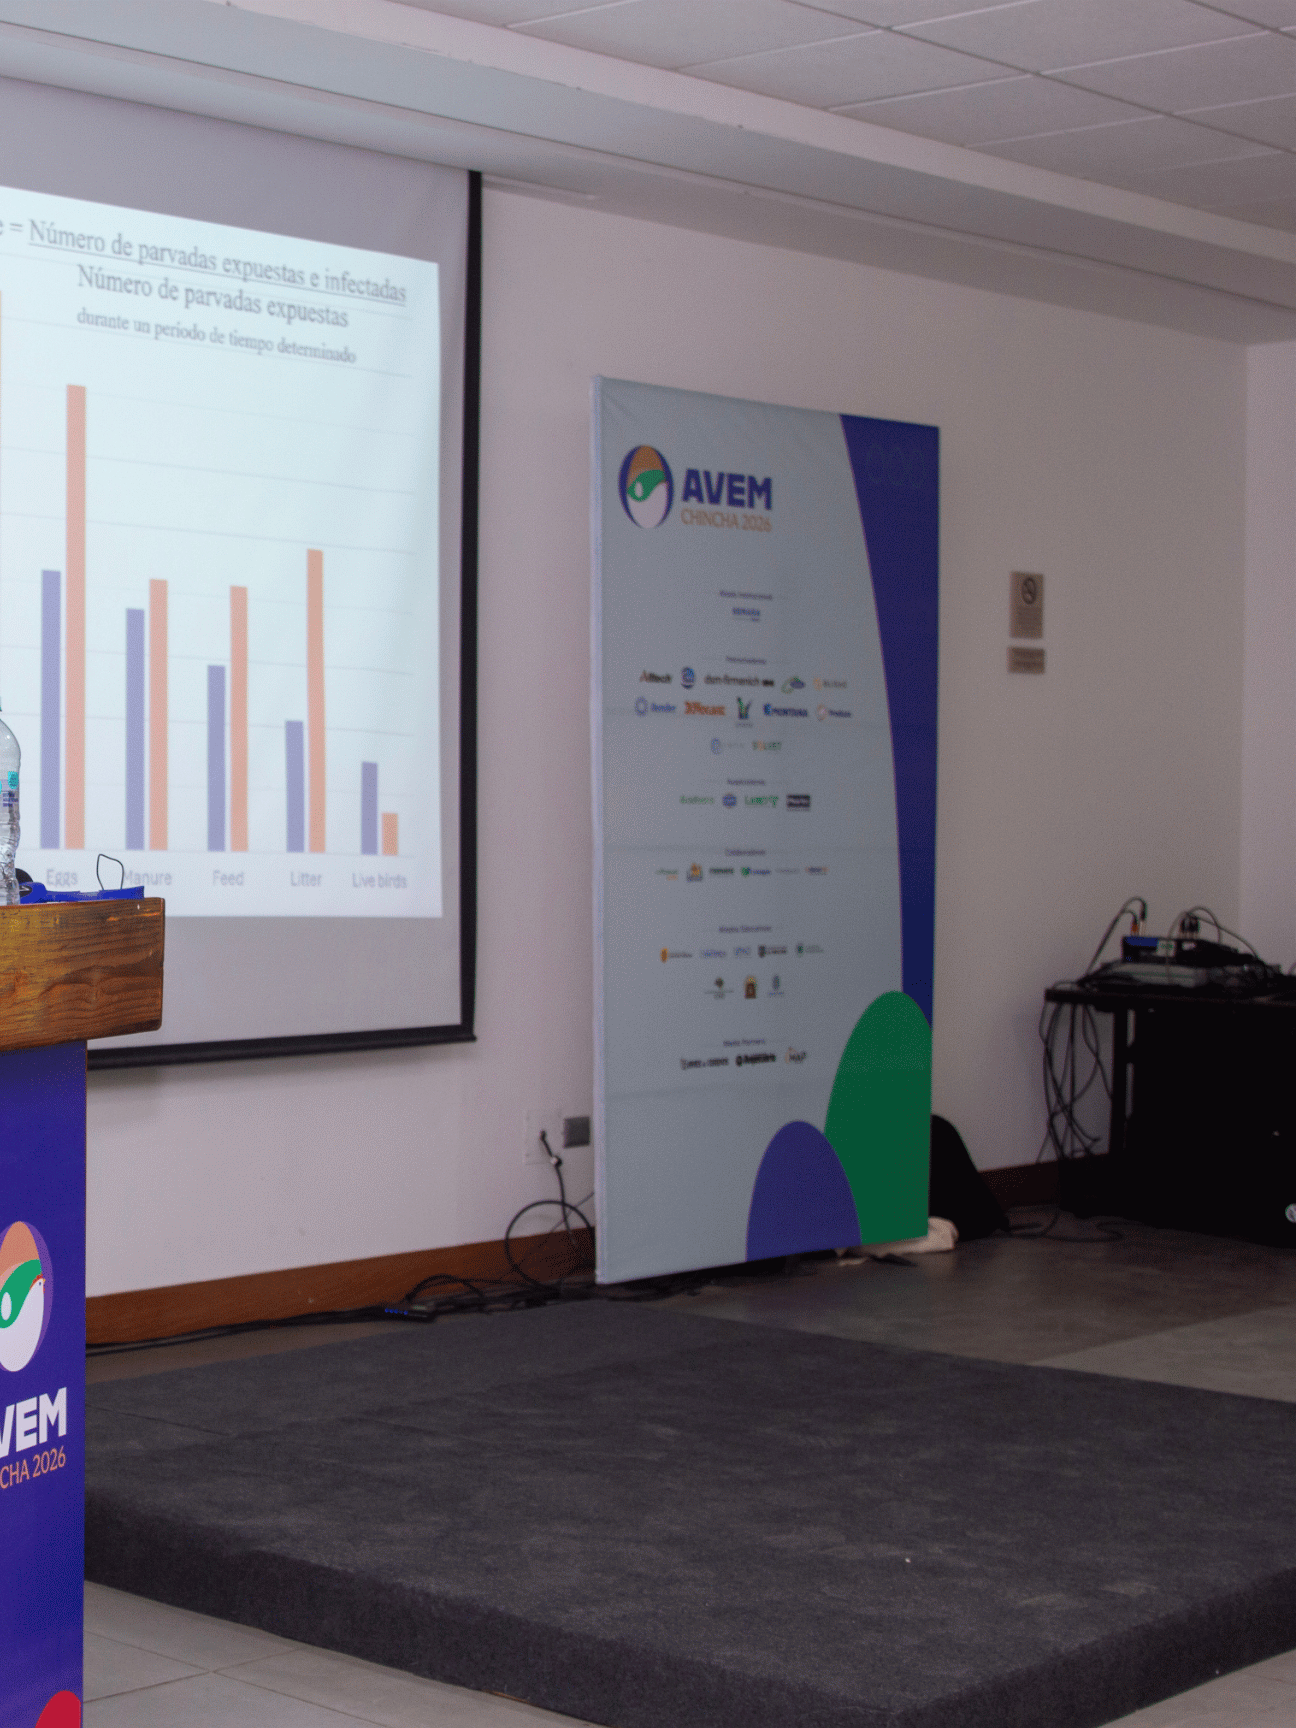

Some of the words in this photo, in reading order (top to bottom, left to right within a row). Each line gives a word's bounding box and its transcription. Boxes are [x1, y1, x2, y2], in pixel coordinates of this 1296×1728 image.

[29, 217, 105, 252] Número
[111, 233, 133, 257] de
[138, 239, 217, 273] parvadas
[222, 256, 304, 290] expuestas
[310, 272, 321, 288] e
[325, 268, 406, 302] infectadas
[77, 263, 152, 298] Número
[158, 277, 179, 302] de
[184, 283, 261, 317] parvadas
[266, 298, 349, 329] expuestas
[77, 306, 129, 331] durante
[134, 318, 151, 333] un
[209, 326, 226, 345] de
[229, 329, 274, 354] tiempo
[277, 336, 356, 364] determinado
[681, 467, 772, 511] AVEM
[680, 508, 739, 530] CHINCHA
[741, 512, 772, 532] 2026
[46, 868, 78, 887] Eggs
[212, 869, 245, 886] Feed
[290, 871, 322, 887] Litter
[352, 872, 376, 889] Live
[378, 872, 407, 889] birds
[32, 1445, 66, 1478] 2026
